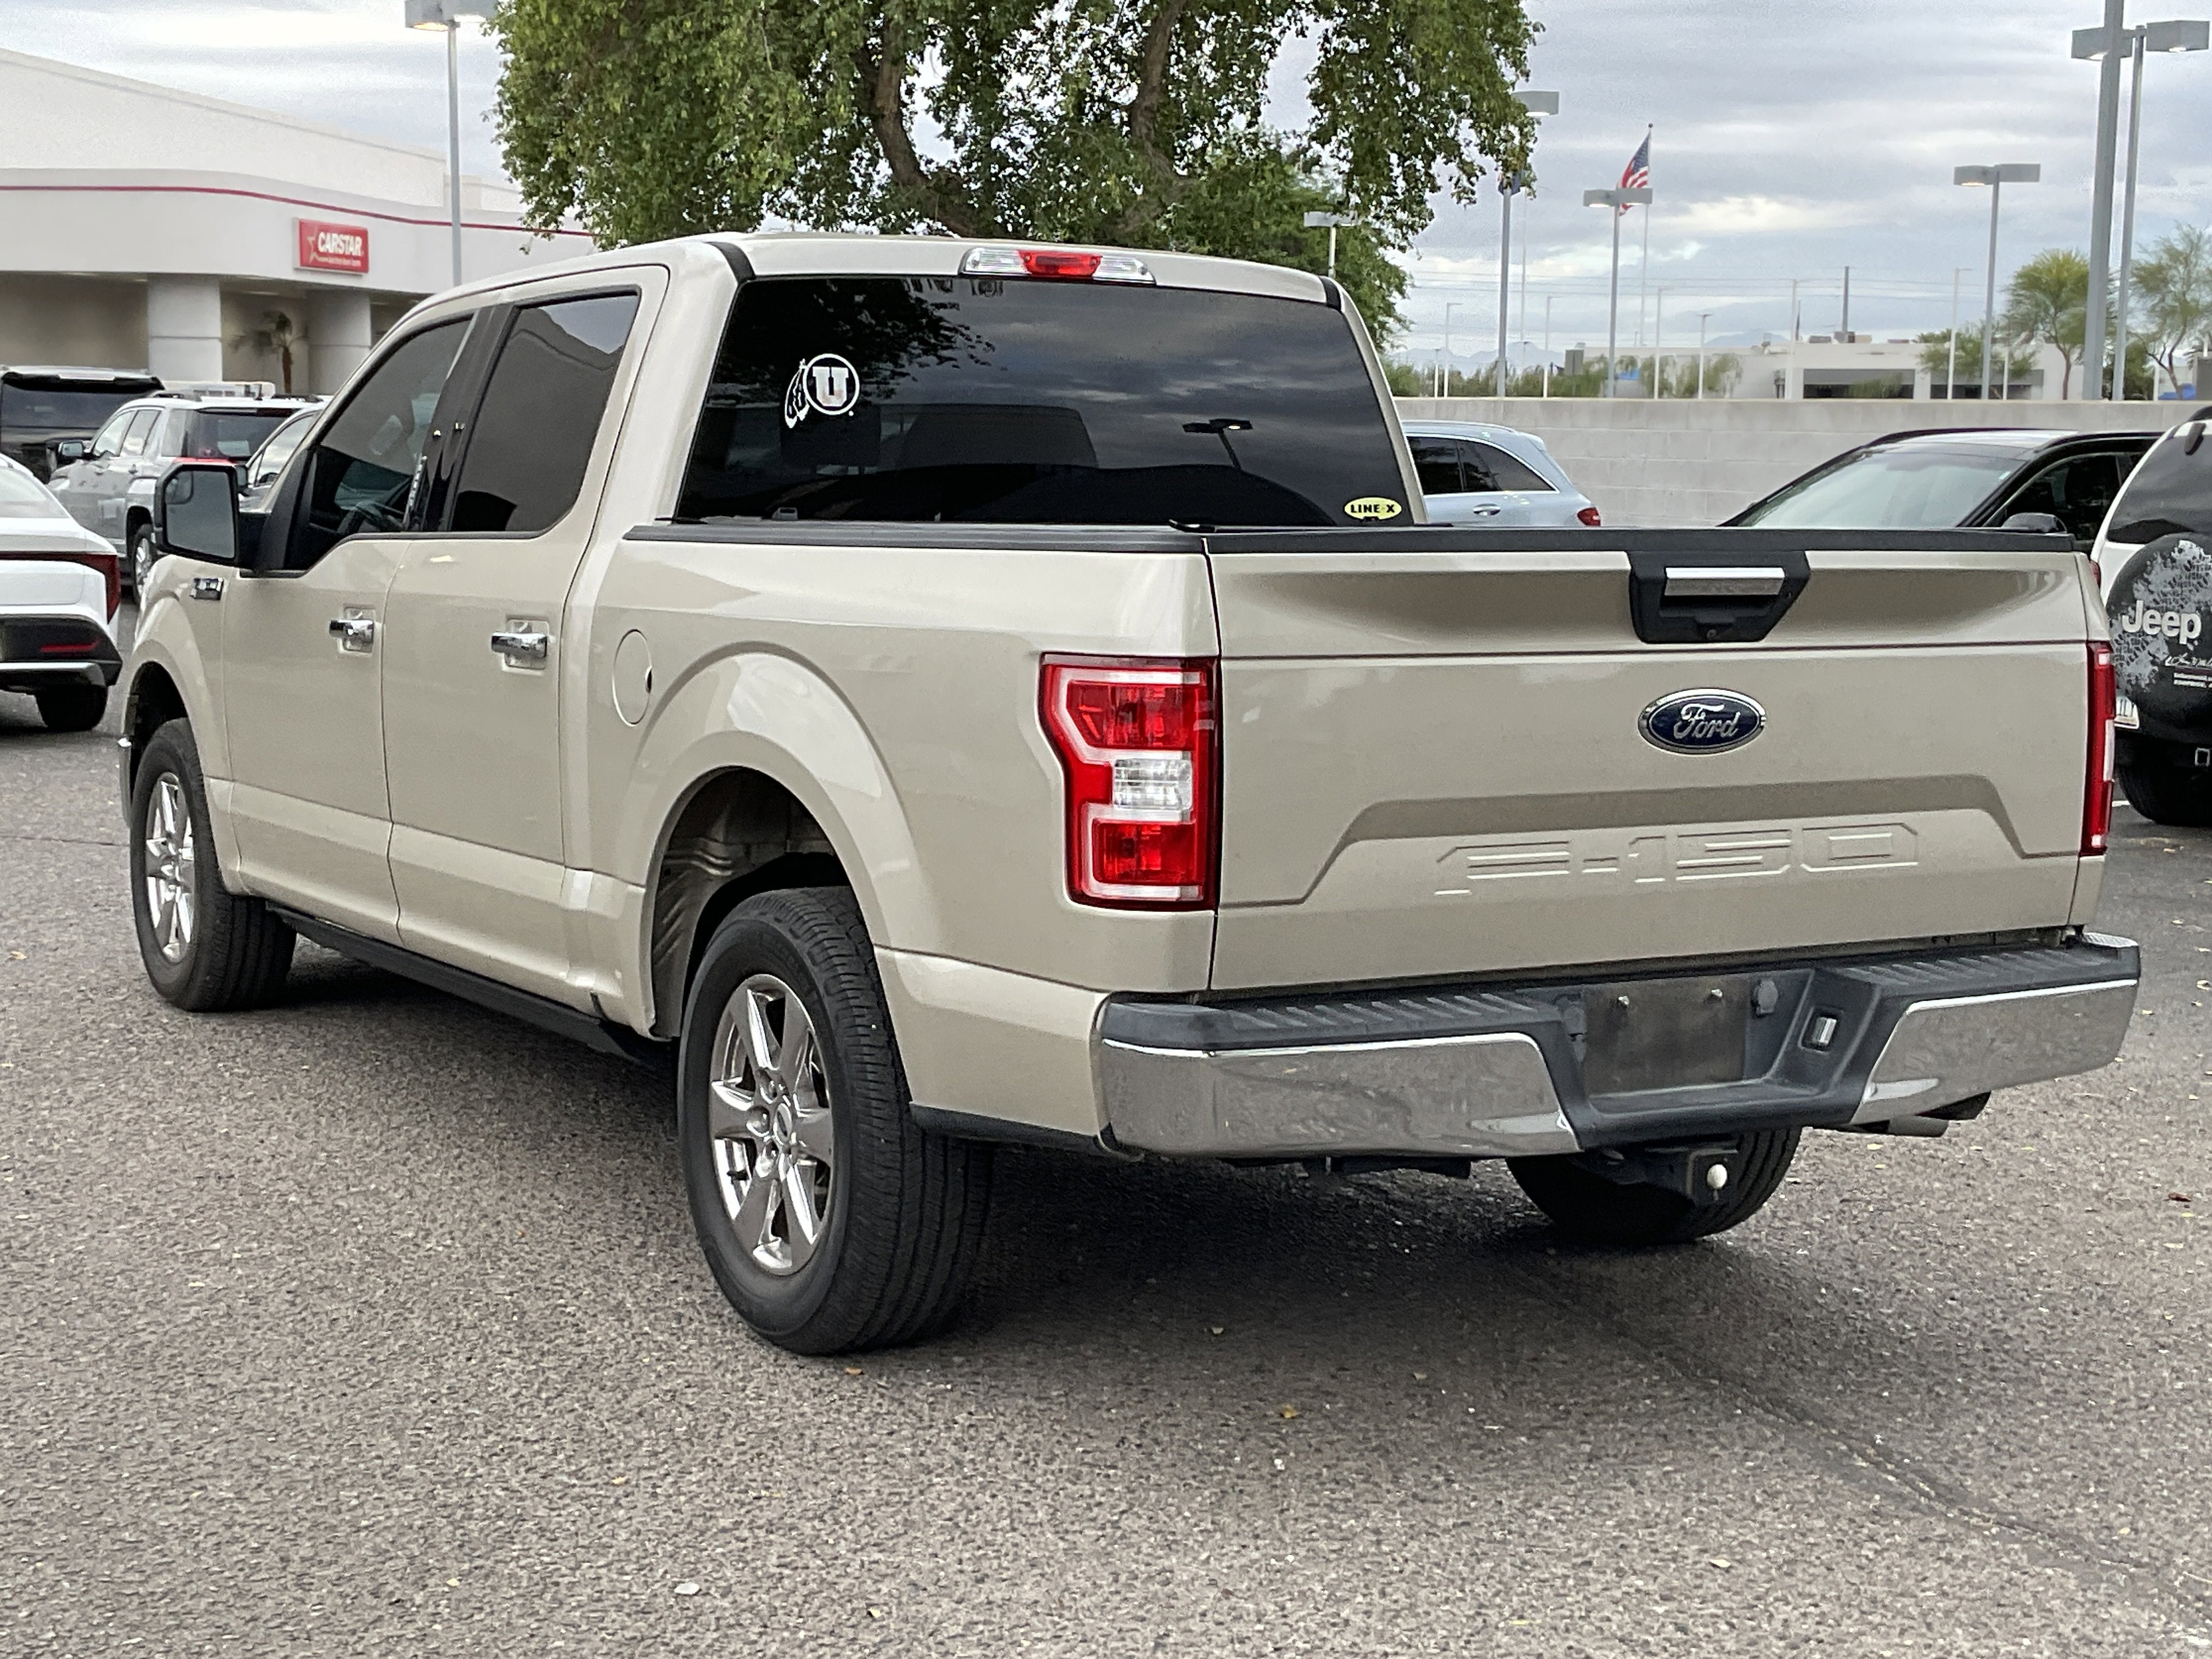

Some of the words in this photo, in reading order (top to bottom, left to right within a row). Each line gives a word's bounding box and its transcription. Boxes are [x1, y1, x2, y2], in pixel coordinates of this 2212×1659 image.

[318, 232, 363, 257] CARSTAR
[812, 366, 849, 407] U
[2121, 600, 2201, 645] Jeep
[1673, 703, 1741, 739] Ford
[1434, 822, 1918, 895] F-150
